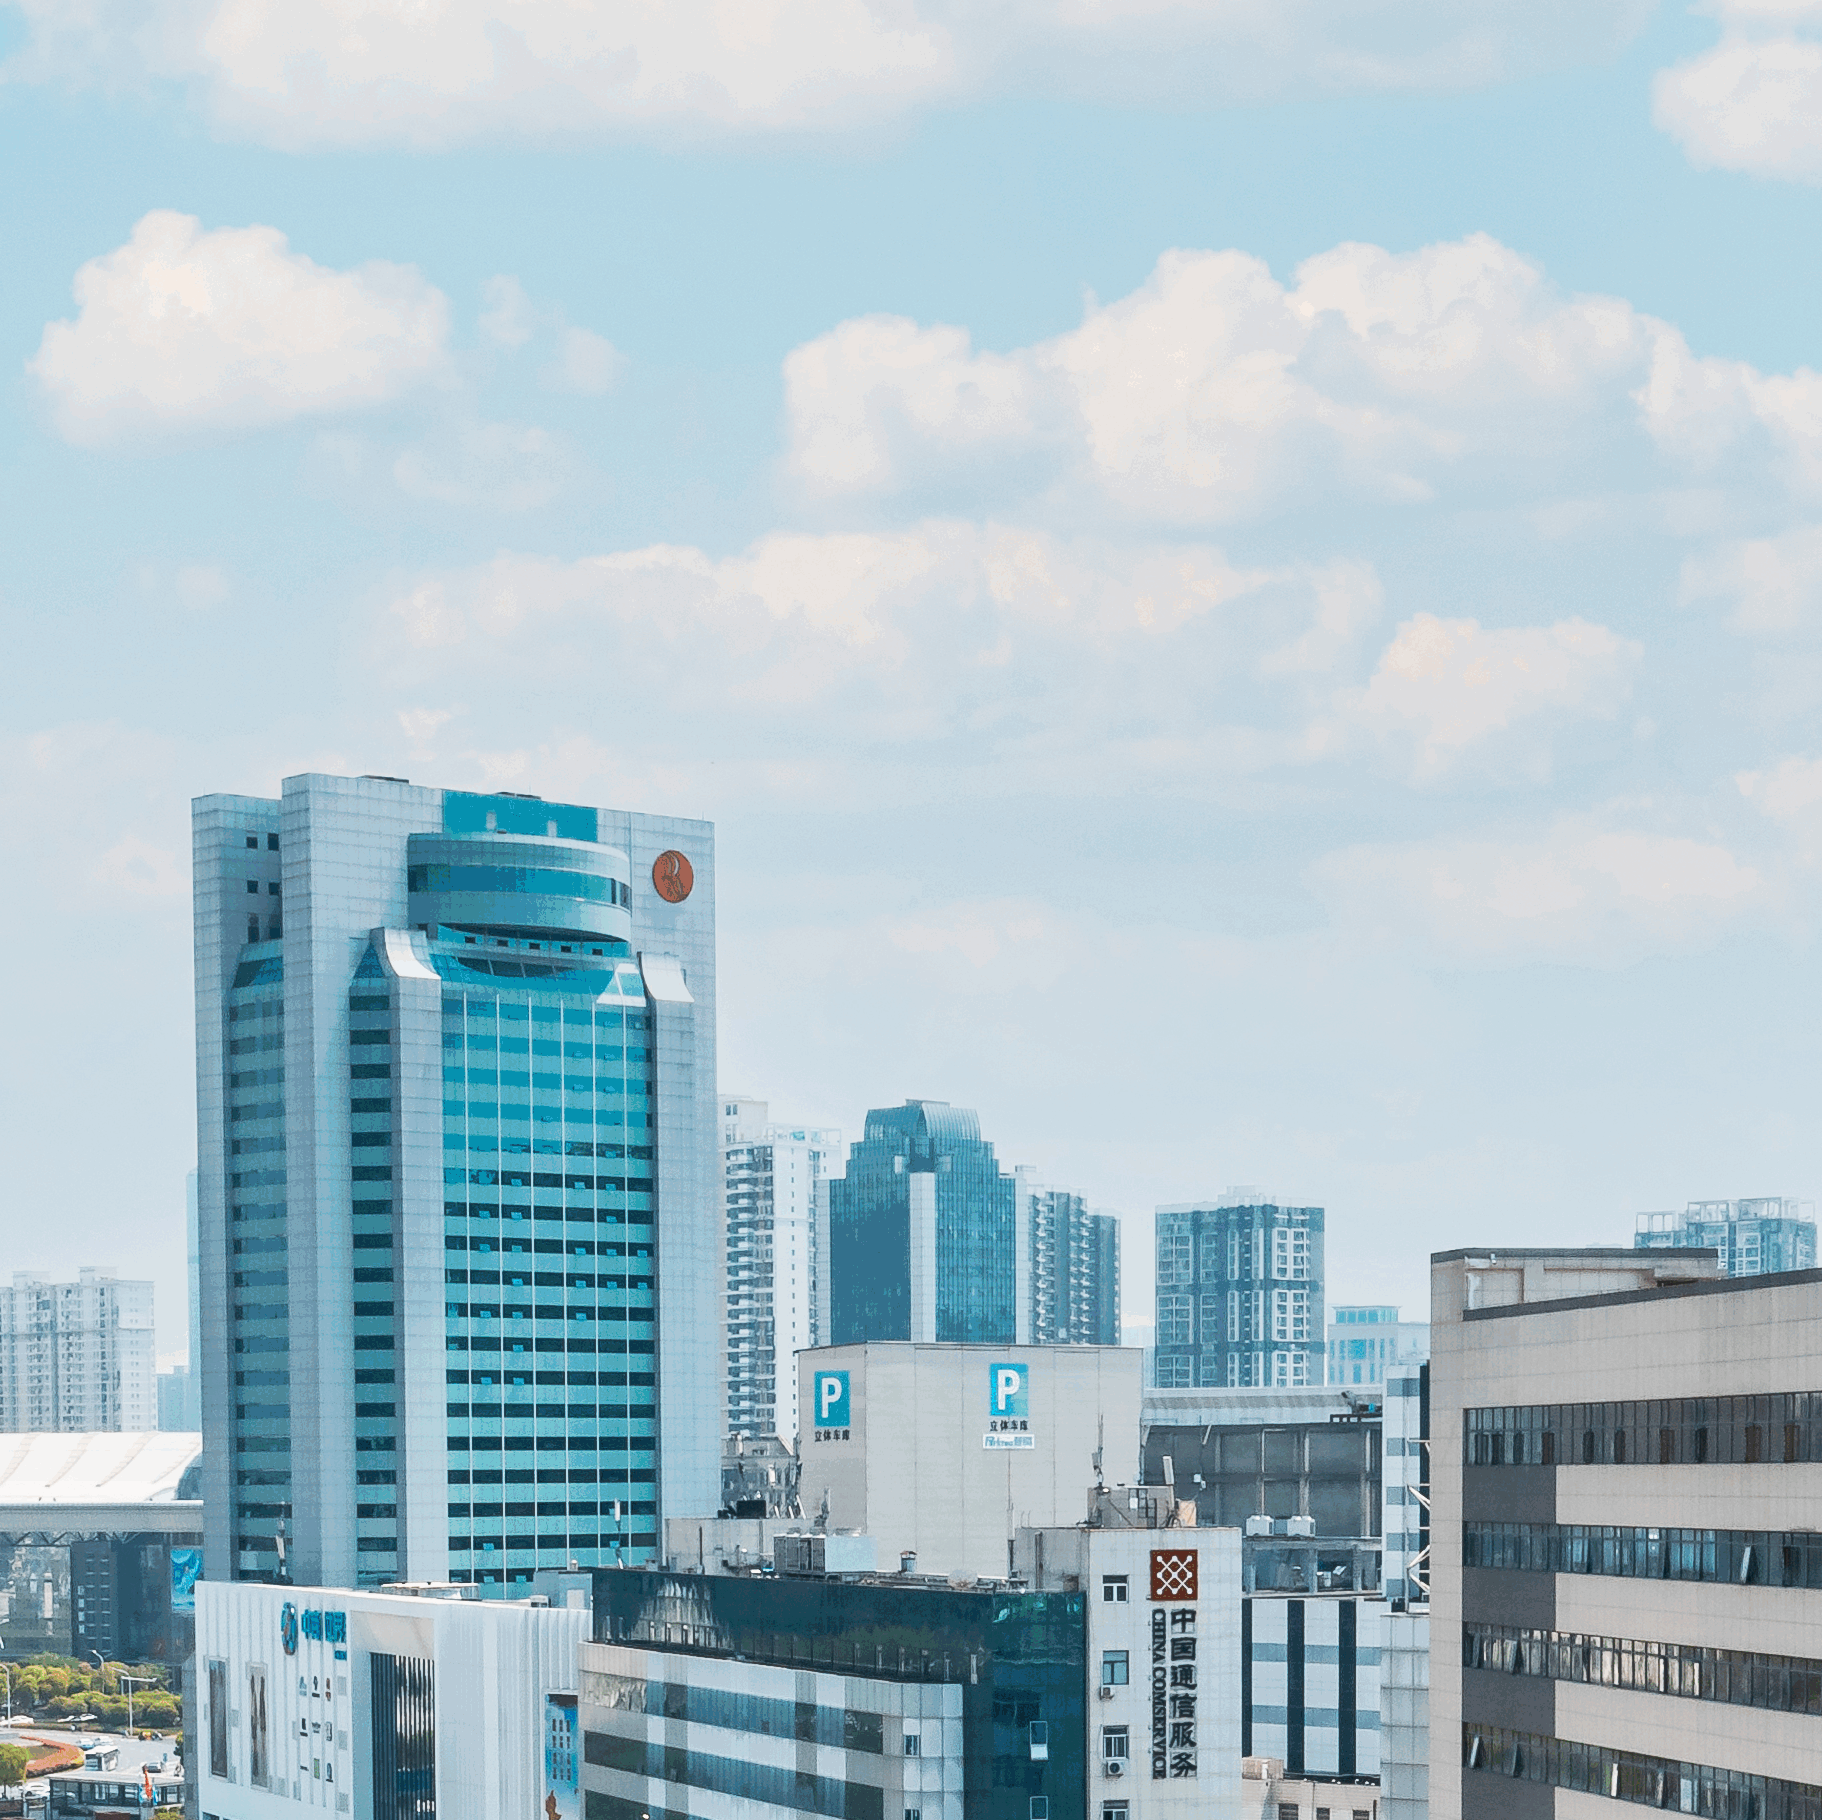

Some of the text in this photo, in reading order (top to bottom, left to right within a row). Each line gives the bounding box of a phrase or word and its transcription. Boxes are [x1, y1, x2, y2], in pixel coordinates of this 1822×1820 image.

[813, 1429, 850, 1442] 立体车库
[990, 1420, 1028, 1431] 立体车库
[1152, 1608, 1166, 1779] CHINA COMSERVICE
[1169, 1608, 1197, 1779] 中国通信服务
